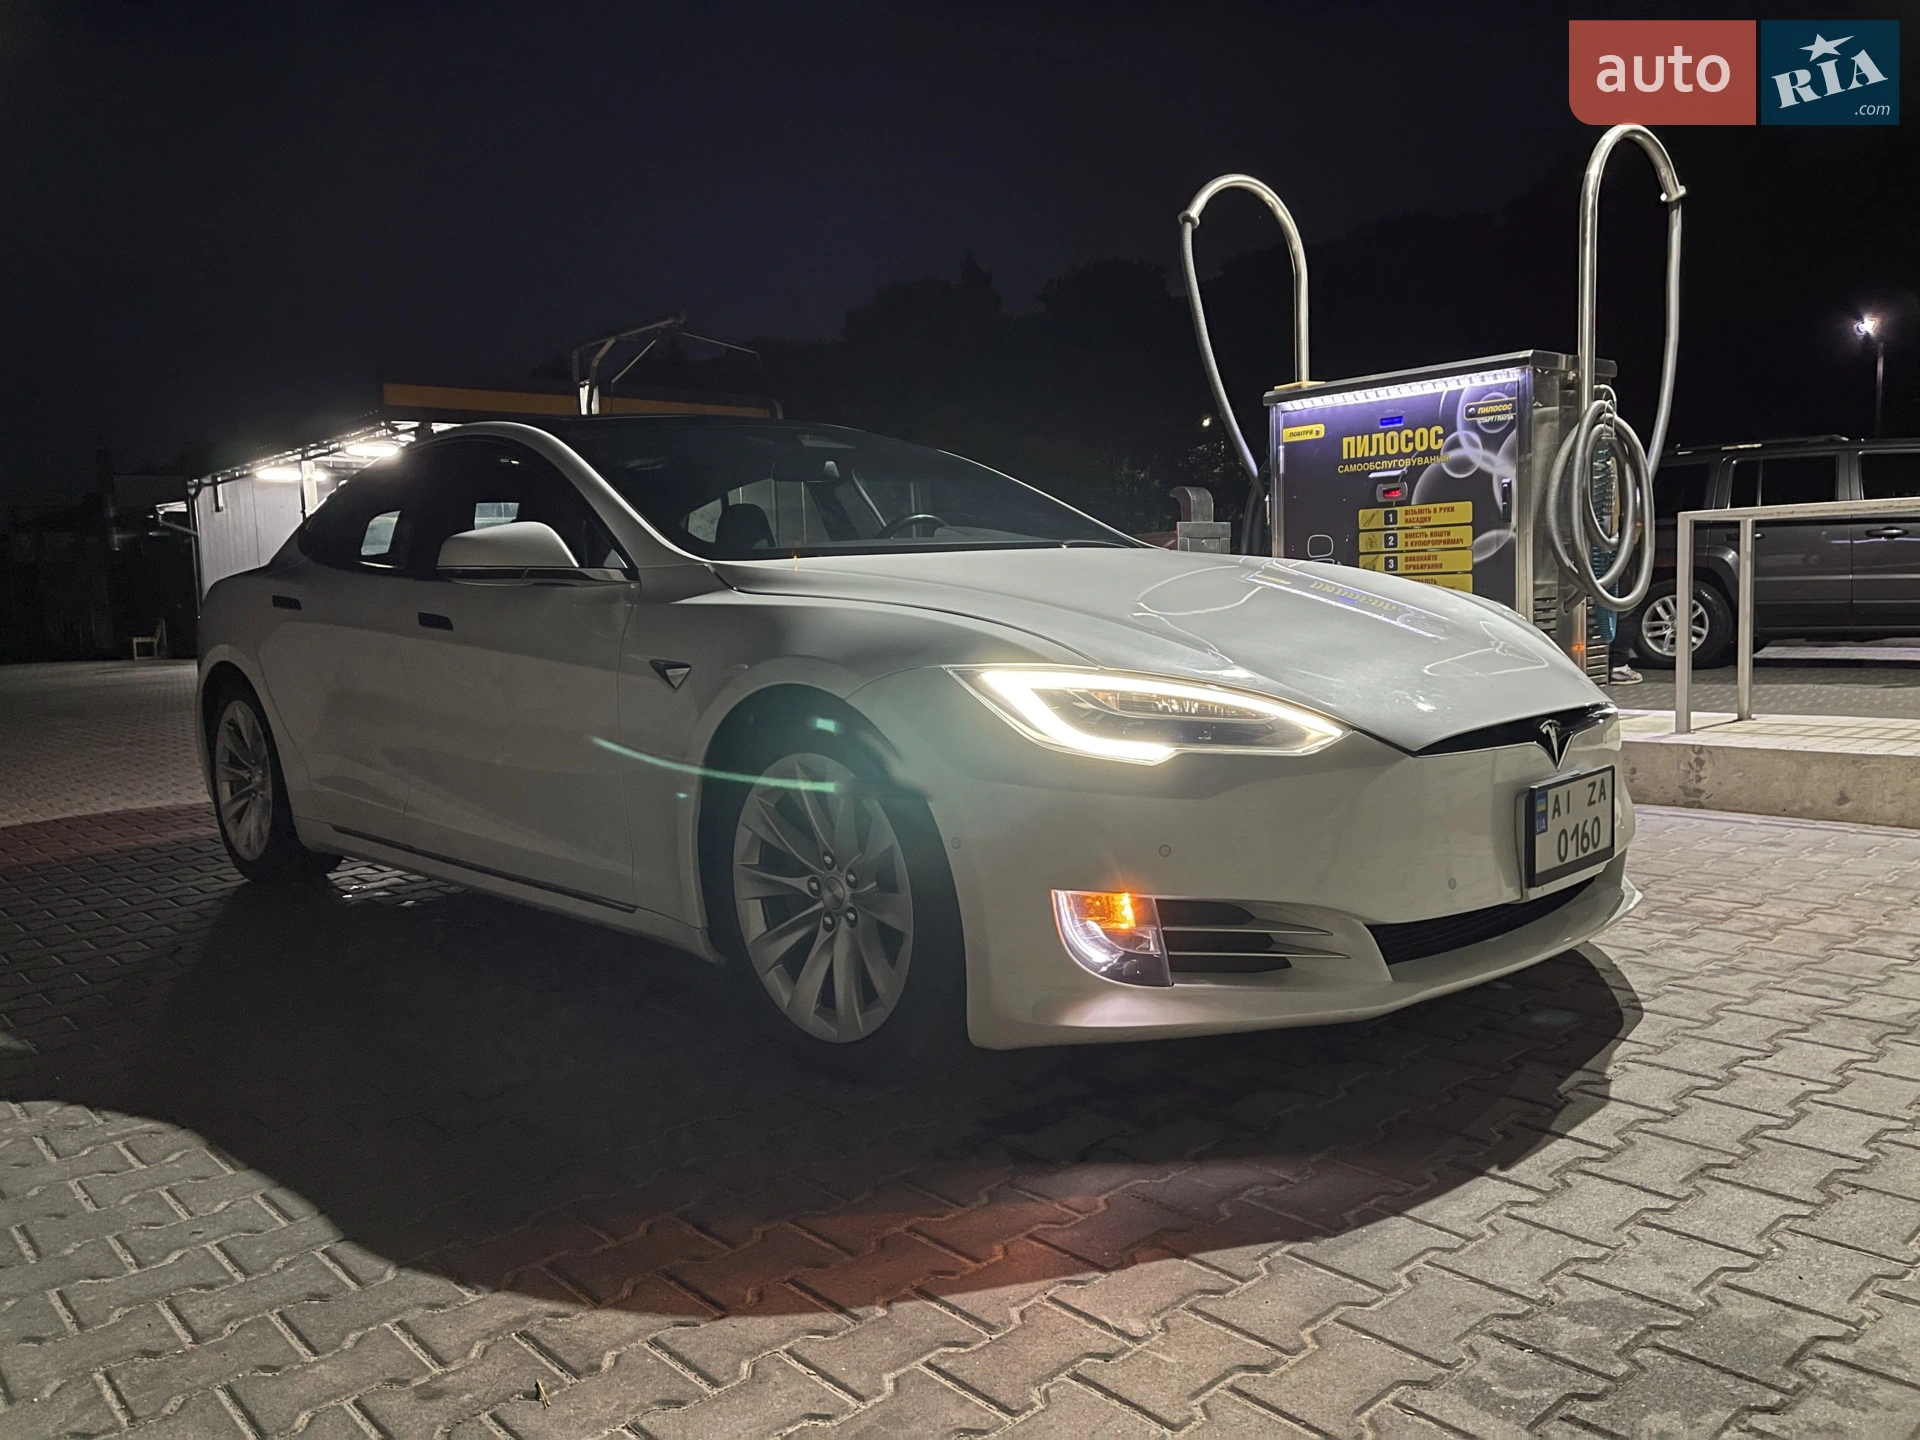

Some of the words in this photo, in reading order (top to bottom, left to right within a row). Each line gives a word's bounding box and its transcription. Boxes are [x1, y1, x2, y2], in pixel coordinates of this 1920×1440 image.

[1477, 403, 1513, 414] ПИЛОСОС
[1289, 429, 1314, 438] ПОВІТРЯ
[1342, 425, 1445, 460] ПИЛОСОС
[1337, 454, 1450, 474] САМООБСЛУГОВУВАННЯ
[1404, 508, 1432, 516] ВІЗЬМІТЬ
[1388, 513, 1393, 523] 1
[1404, 516, 1432, 524] НАСАДКУ
[1430, 530, 1451, 538] КОШТИ
[1388, 536, 1394, 546] 2
[1410, 538, 1464, 547] КУПЮРОПРИЙМАЧ
[1388, 559, 1394, 569] 3
[1404, 555, 1438, 563] ВИКОНАЙТЕ
[1404, 562, 1443, 571] ПРИБИРАННЯ
[1551, 790, 1570, 820] AI
[1587, 778, 1607, 807] ZA
[1536, 818, 1547, 832] UA
[1557, 815, 1601, 863] 0160
